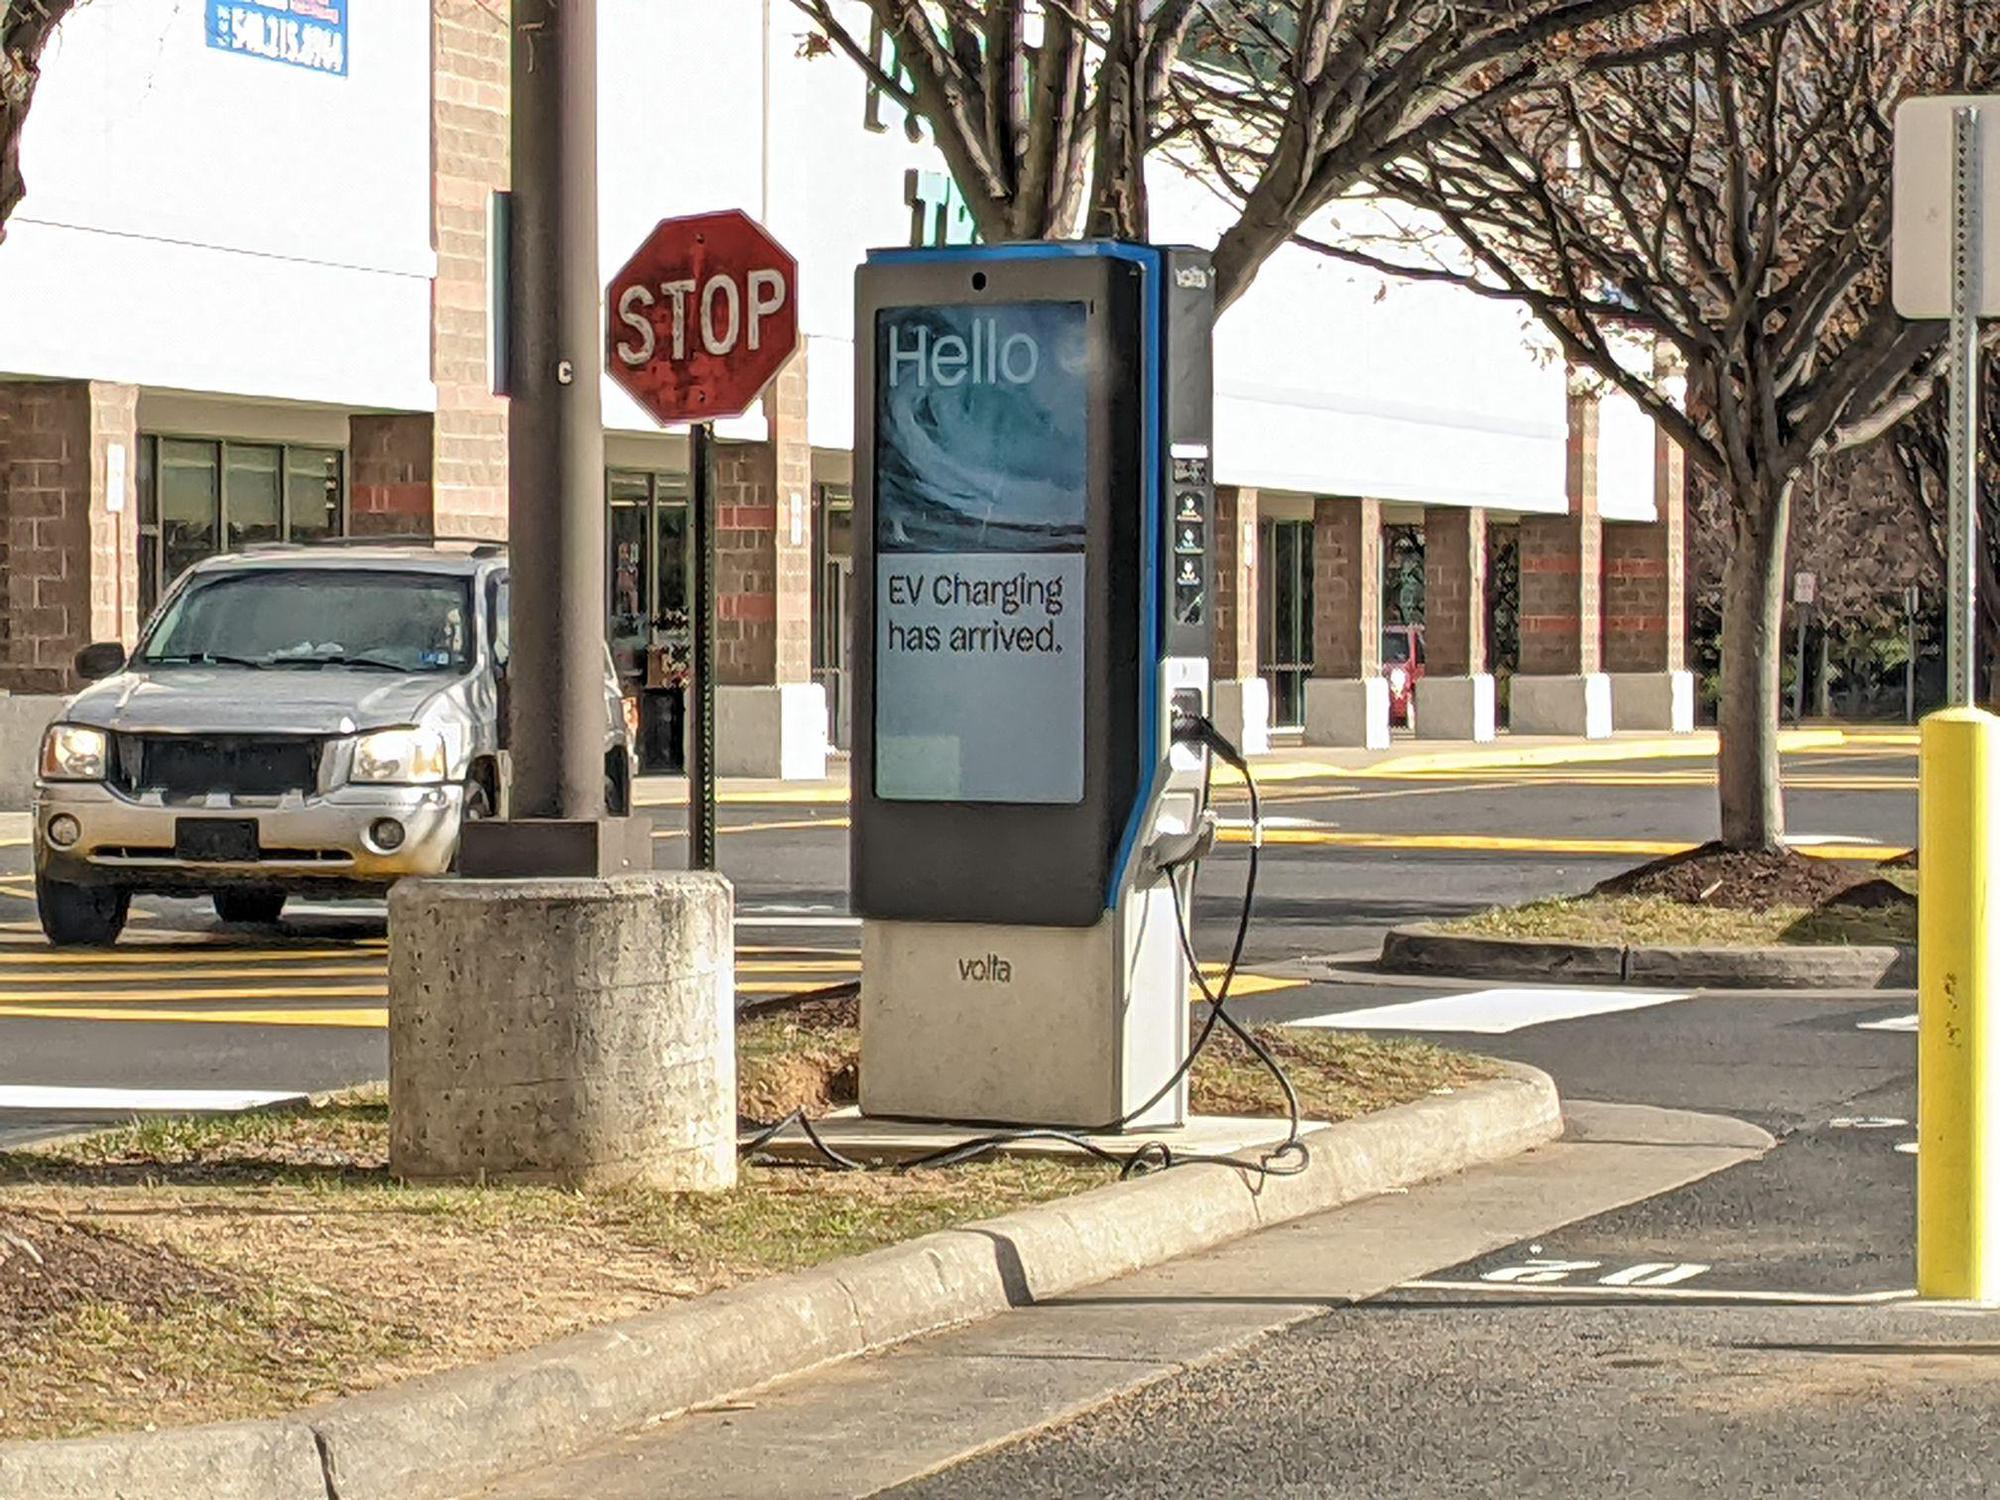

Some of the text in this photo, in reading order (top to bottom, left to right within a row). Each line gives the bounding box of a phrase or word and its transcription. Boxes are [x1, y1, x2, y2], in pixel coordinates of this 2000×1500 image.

[616, 268, 786, 365] STOP
[889, 318, 1039, 387] Hello
[889, 572, 1063, 615] EV Charging
[889, 619, 1063, 653] has arrived.
[958, 953, 1011, 982] volta
